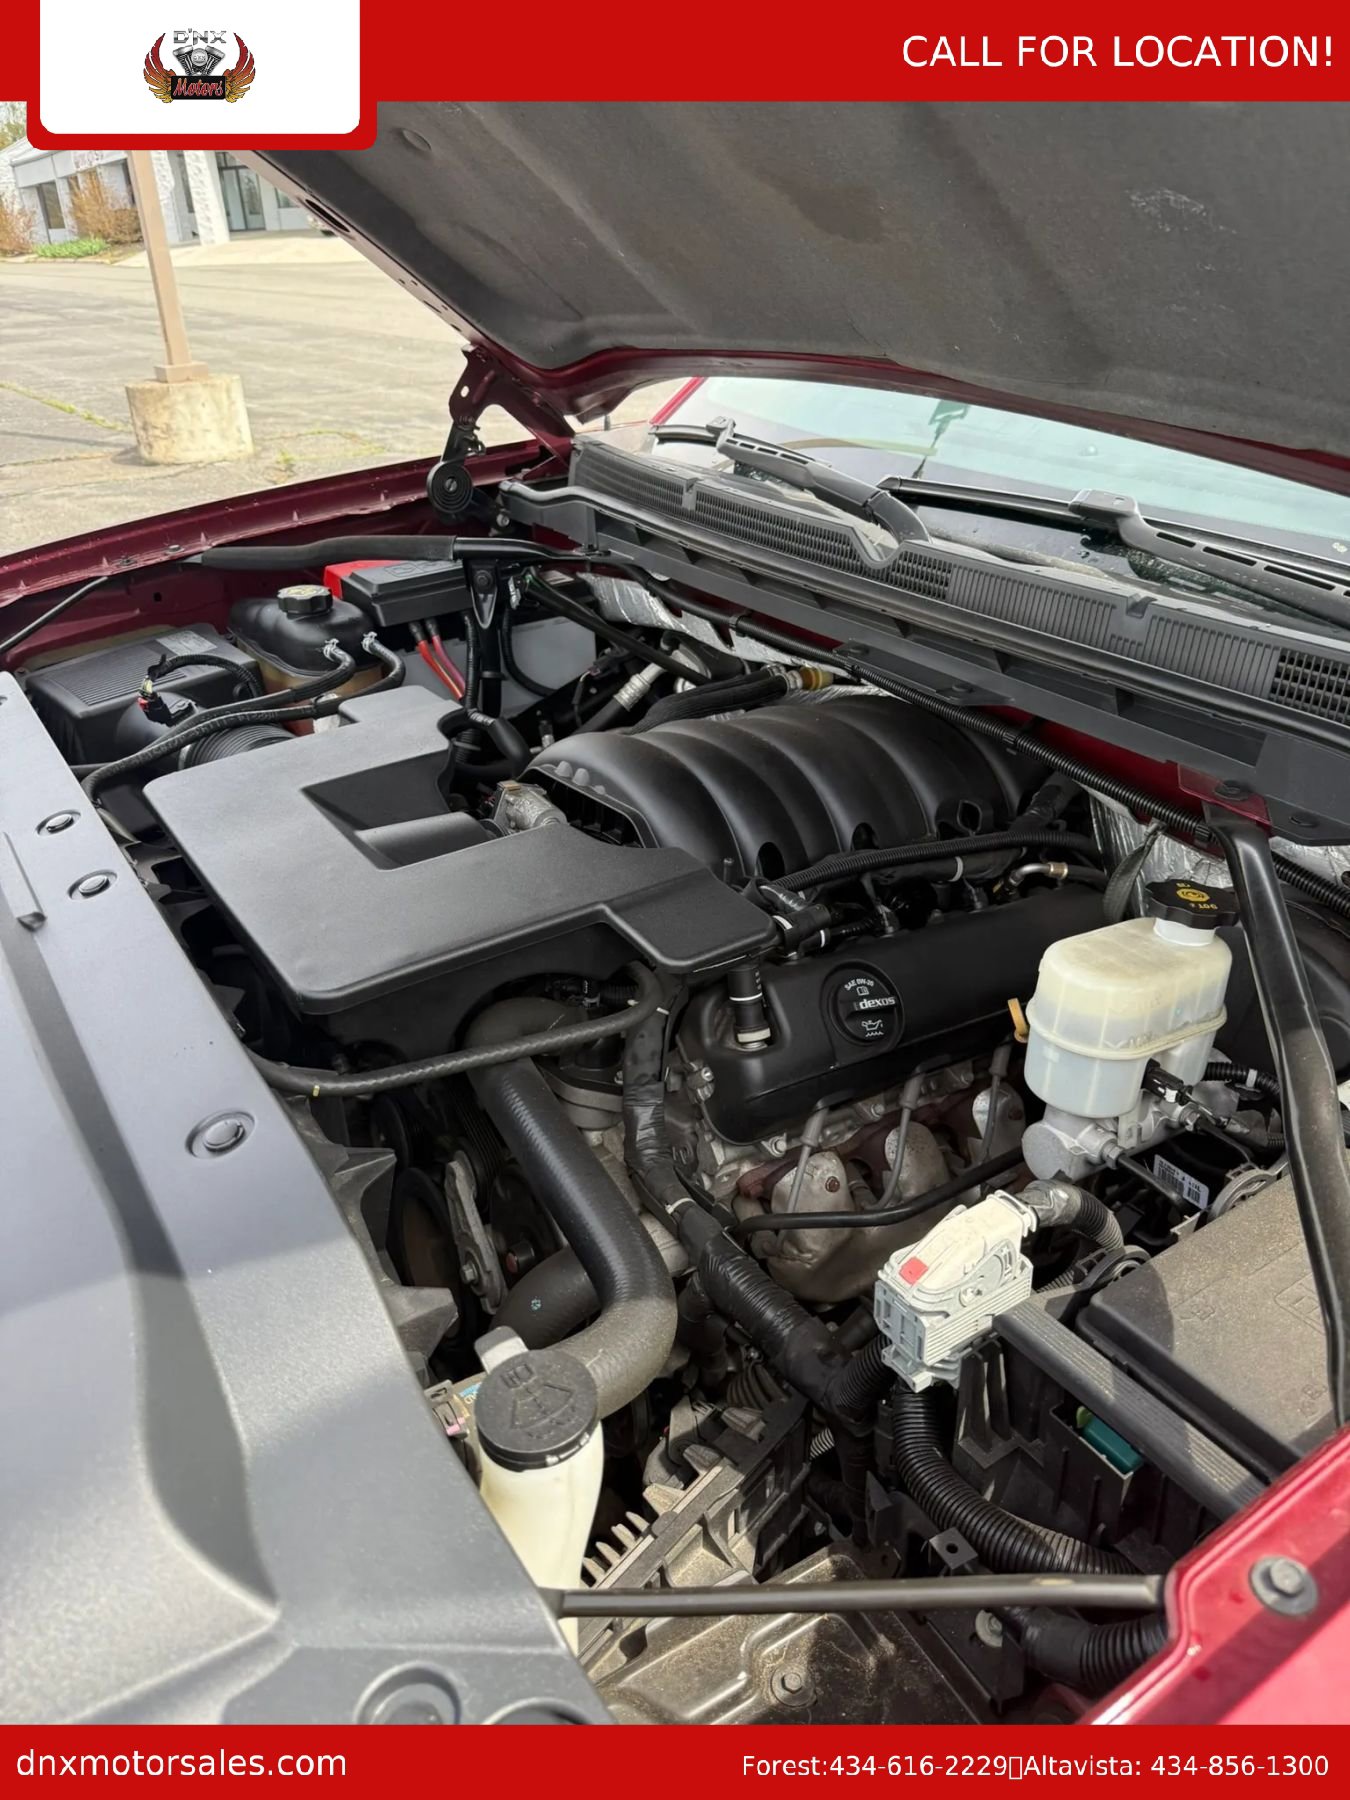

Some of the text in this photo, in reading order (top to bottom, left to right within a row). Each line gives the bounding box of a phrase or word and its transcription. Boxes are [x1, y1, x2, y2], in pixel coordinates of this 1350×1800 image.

[844, 978, 875, 991] SAE 0W-20
[859, 996, 896, 1010] dexos
